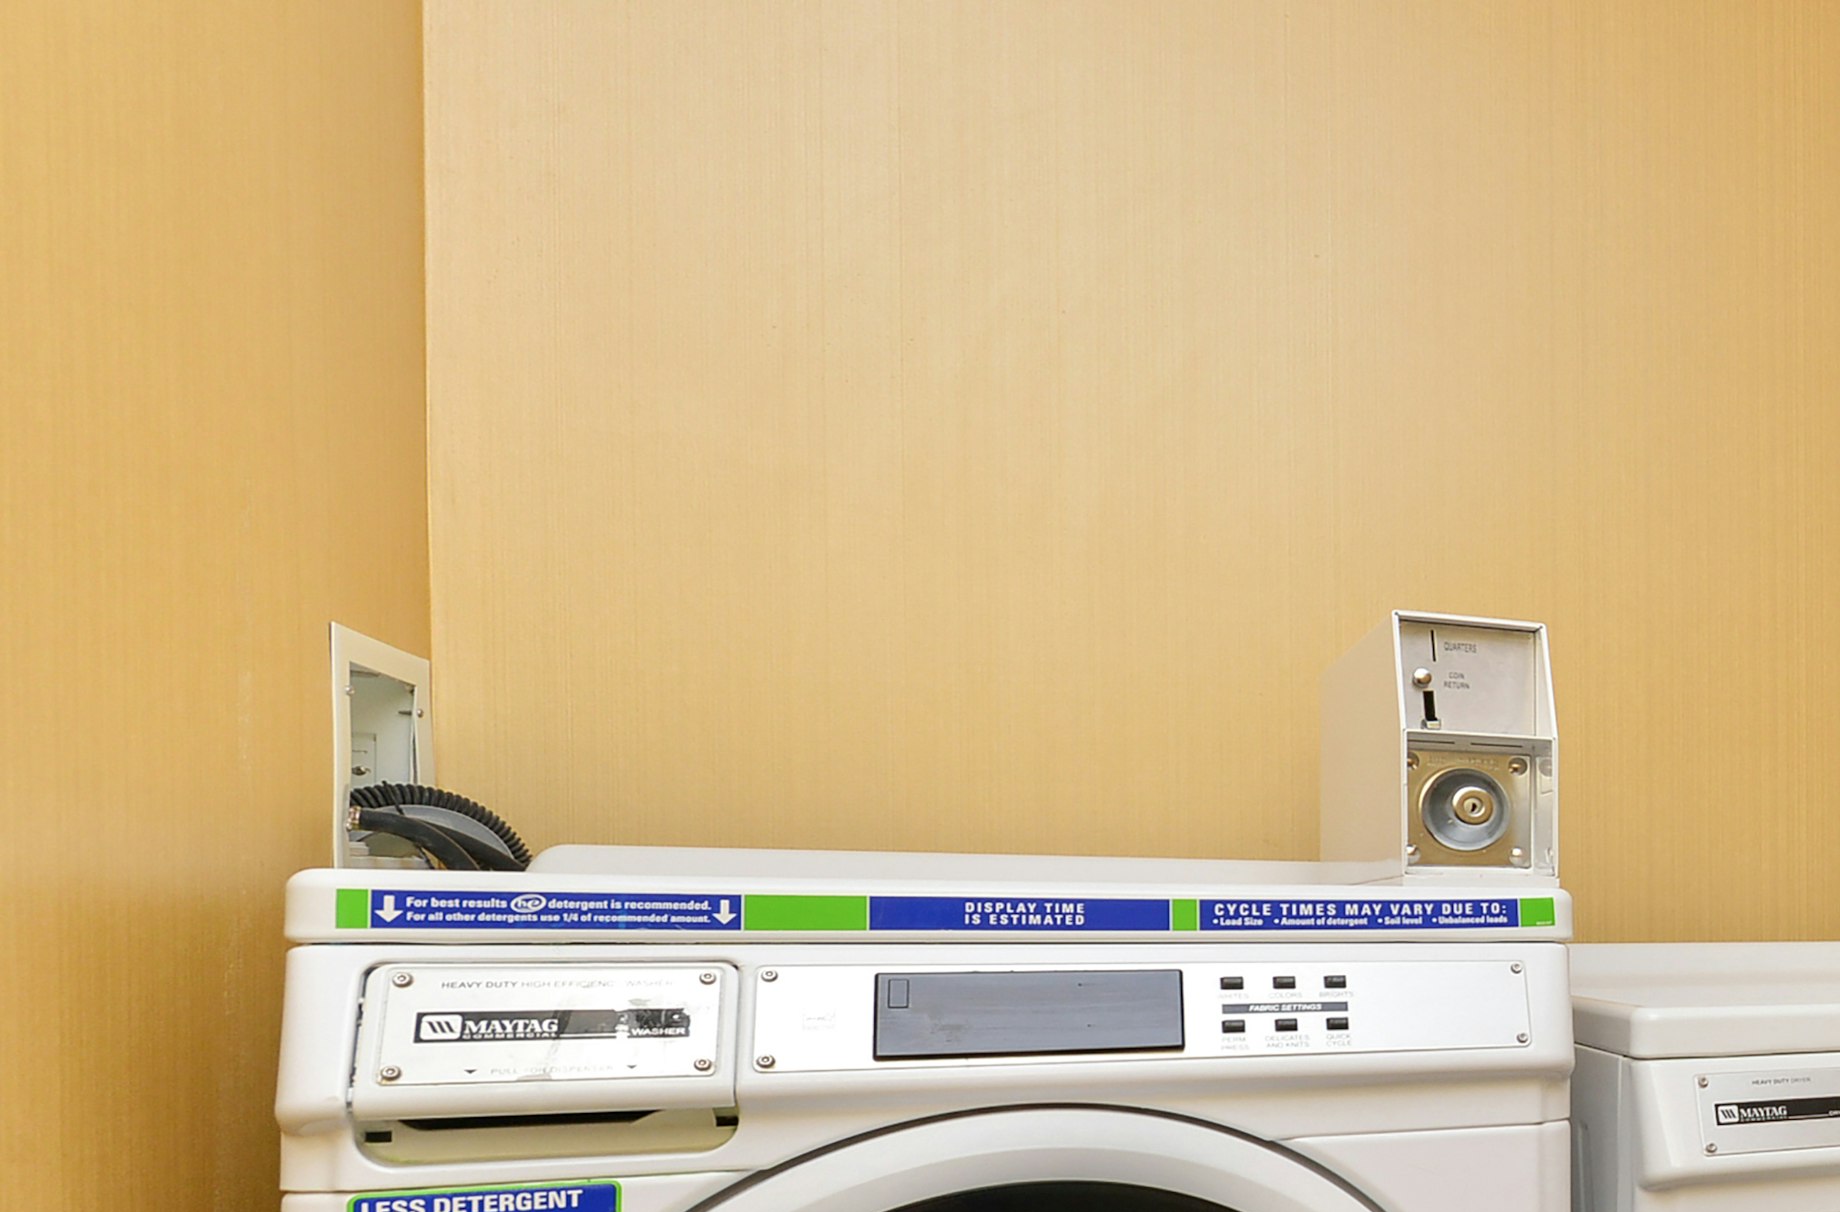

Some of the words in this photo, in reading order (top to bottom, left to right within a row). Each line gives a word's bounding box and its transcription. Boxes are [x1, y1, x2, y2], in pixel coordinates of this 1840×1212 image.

[1444, 641, 1477, 653] QUARTERS
[1448, 671, 1465, 680] COIN
[1443, 681, 1470, 690] RETURN
[406, 896, 429, 908] For
[431, 897, 460, 908] best
[462, 898, 507, 909] results
[548, 899, 608, 911] detergent
[610, 899, 622, 909] is
[624, 899, 712, 910] recommended.
[964, 902, 1037, 913] DISPLAY
[1044, 903, 1085, 914] TIME
[1214, 903, 1272, 916] CYCLE
[1280, 903, 1337, 916] TIMES
[1345, 903, 1382, 916] MAY
[1390, 903, 1434, 915] VARY
[1442, 902, 1473, 915] DUE
[1481, 902, 1507, 914] TO:
[406, 911, 426, 921] For
[428, 912, 443, 921] all
[445, 912, 476, 922] other
[477, 912, 538, 923] detergents
[540, 914, 560, 922] use
[562, 912, 579, 922] 1/4
[580, 913, 591, 922] of
[593, 913, 668, 923] recommended
[670, 914, 711, 923] amount.
[964, 914, 981, 925] IS
[989, 914, 1085, 925] ESTIMATED
[1220, 917, 1242, 926] Load
[1244, 917, 1264, 926] Size
[1280, 917, 1315, 926] Amount
[1316, 917, 1325, 926] of
[1326, 917, 1368, 927] detergent
[1384, 916, 1401, 925] Soil
[1402, 916, 1422, 925] level
[1438, 916, 1485, 924] Unbalanced
[1486, 915, 1508, 924] loads
[441, 981, 483, 989] HEAVY
[485, 981, 518, 989] DUTY
[521, 980, 550, 988] HIGH
[553, 980, 616, 989] EFFICIENC
[1268, 991, 1303, 999] COLORS
[1319, 990, 1354, 998] BRIGHTS
[1249, 1003, 1280, 1012] FABRIC
[1281, 1003, 1322, 1012] SETTINGS
[463, 1019, 559, 1035] MAYTAG
[631, 1027, 686, 1036] WASHER
[1264, 1033, 1310, 1042] DELICATES
[1326, 1033, 1351, 1041] QUICK
[1266, 1041, 1284, 1049] AND
[1791, 1076, 1812, 1084] DRYER
[1739, 1105, 1788, 1119] MAYTAG
